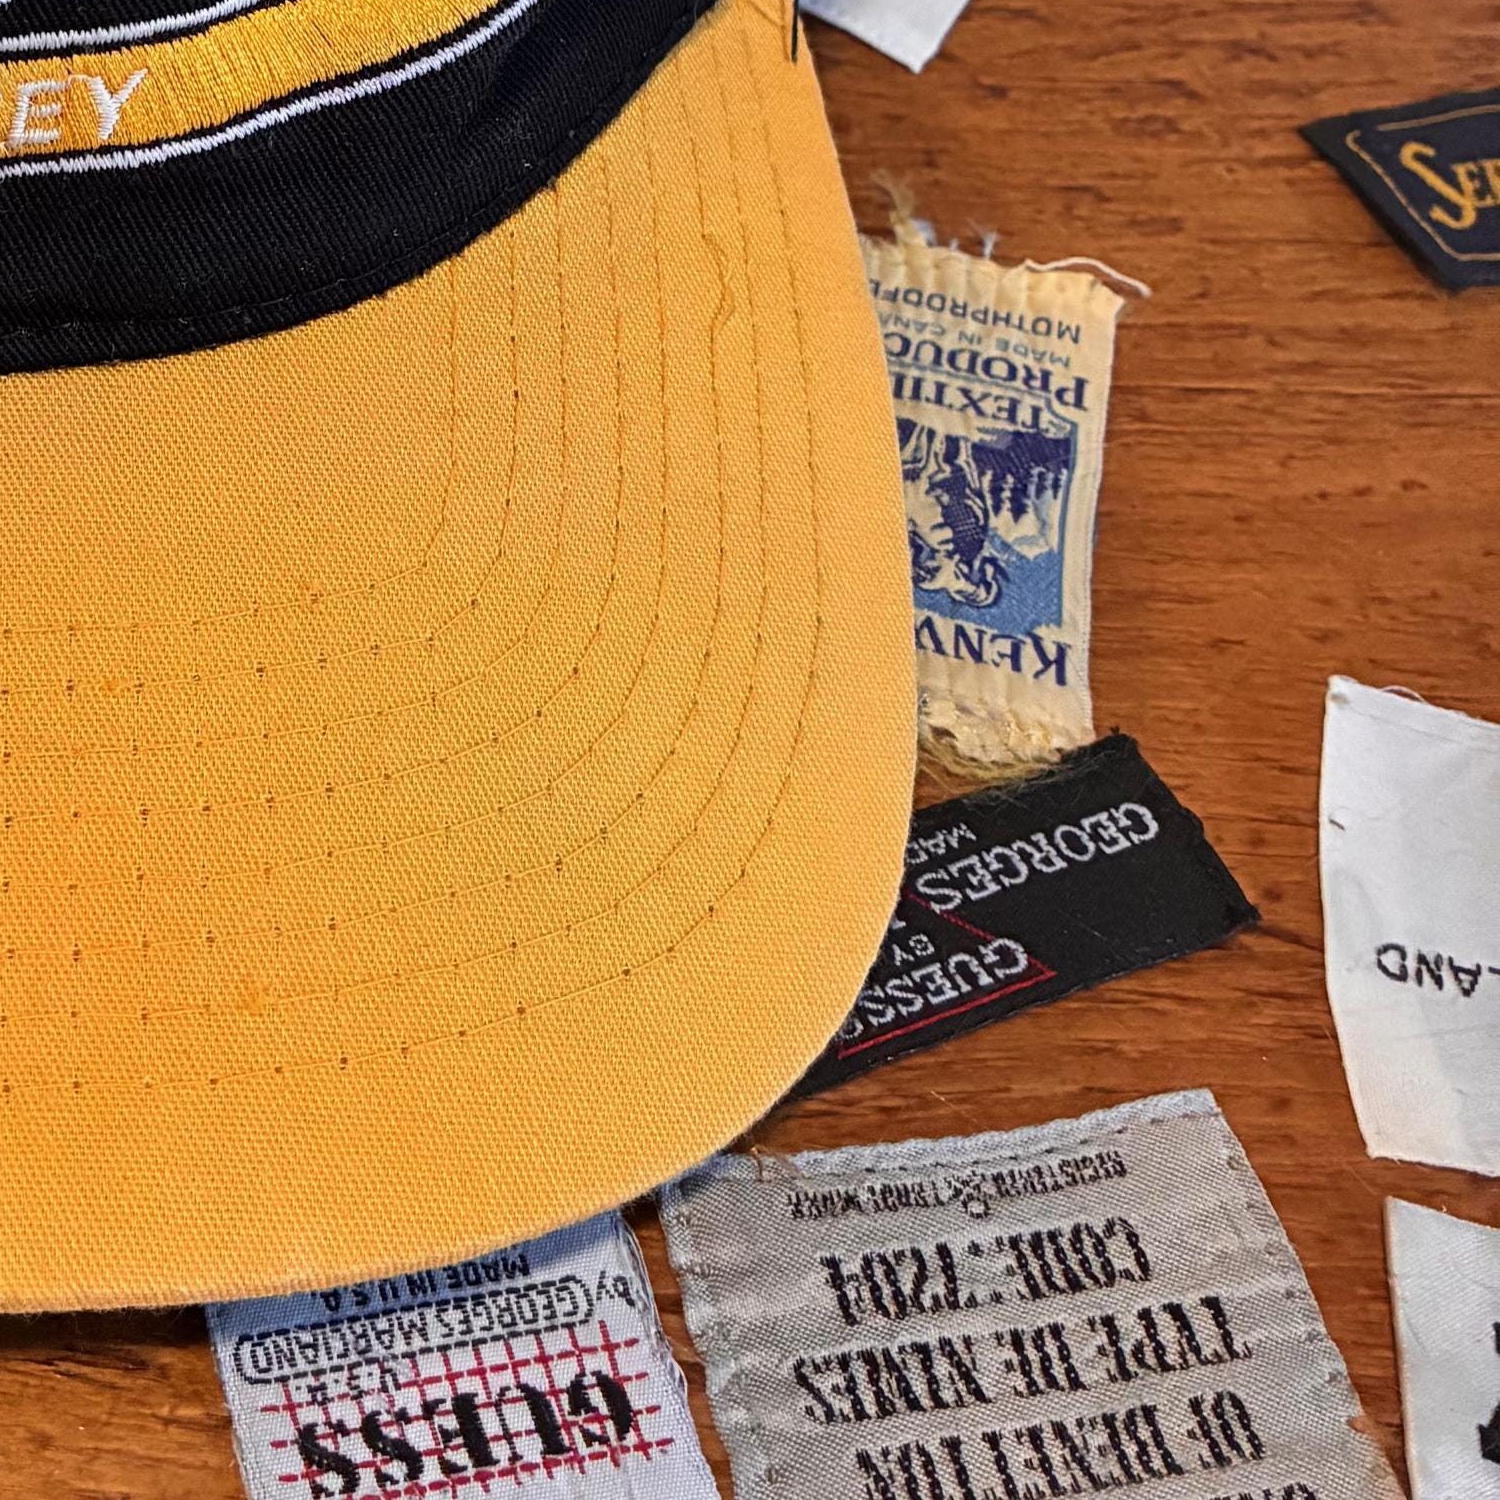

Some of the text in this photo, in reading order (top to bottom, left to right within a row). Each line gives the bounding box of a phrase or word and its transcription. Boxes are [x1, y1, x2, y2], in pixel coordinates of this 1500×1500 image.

[957, 330, 983, 346] IN
[915, 801, 1160, 914] GEORGES
[891, 932, 936, 967] BY
[1376, 941, 1500, 1000] AND
[404, 1272, 438, 1298] IN
[446, 1252, 530, 1291] MADE
[249, 1270, 637, 1373] by GEORGES MARCIANO
[995, 1320, 1090, 1400] DE
[1086, 1295, 1255, 1385] TYPE
[298, 1368, 634, 1500] GUESS
[854, 1389, 1268, 1500] OF BENETTON
